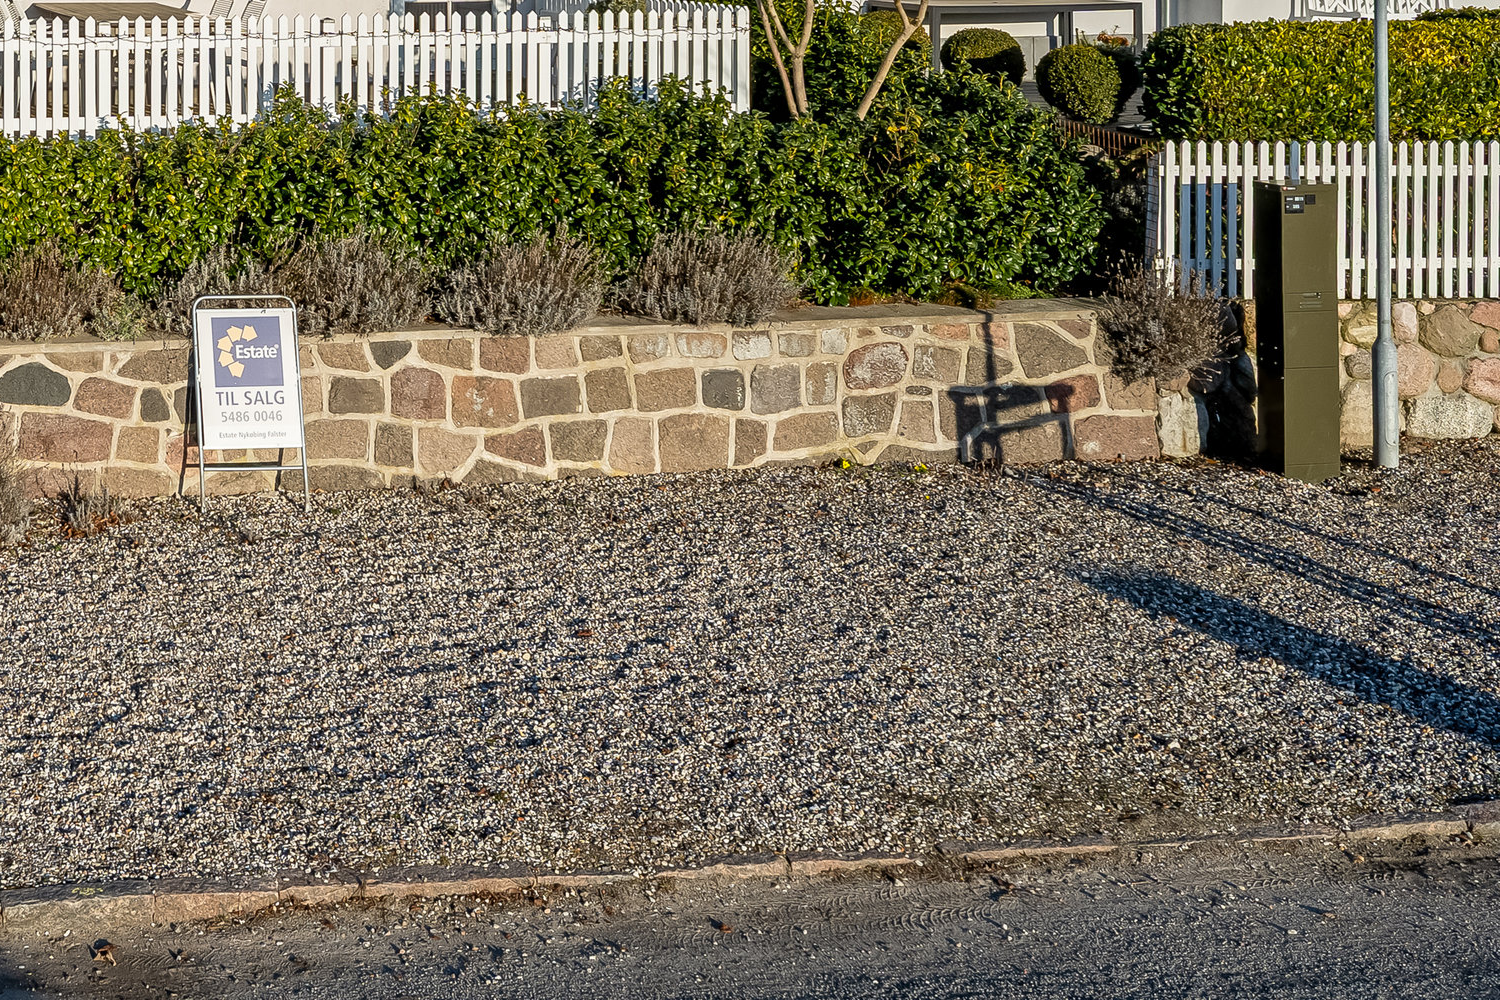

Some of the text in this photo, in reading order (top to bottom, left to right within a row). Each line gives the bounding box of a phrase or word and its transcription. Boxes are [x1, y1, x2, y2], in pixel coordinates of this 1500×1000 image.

[215, 390, 285, 406] TIL SALG
[221, 410, 283, 423] 5486 0046
